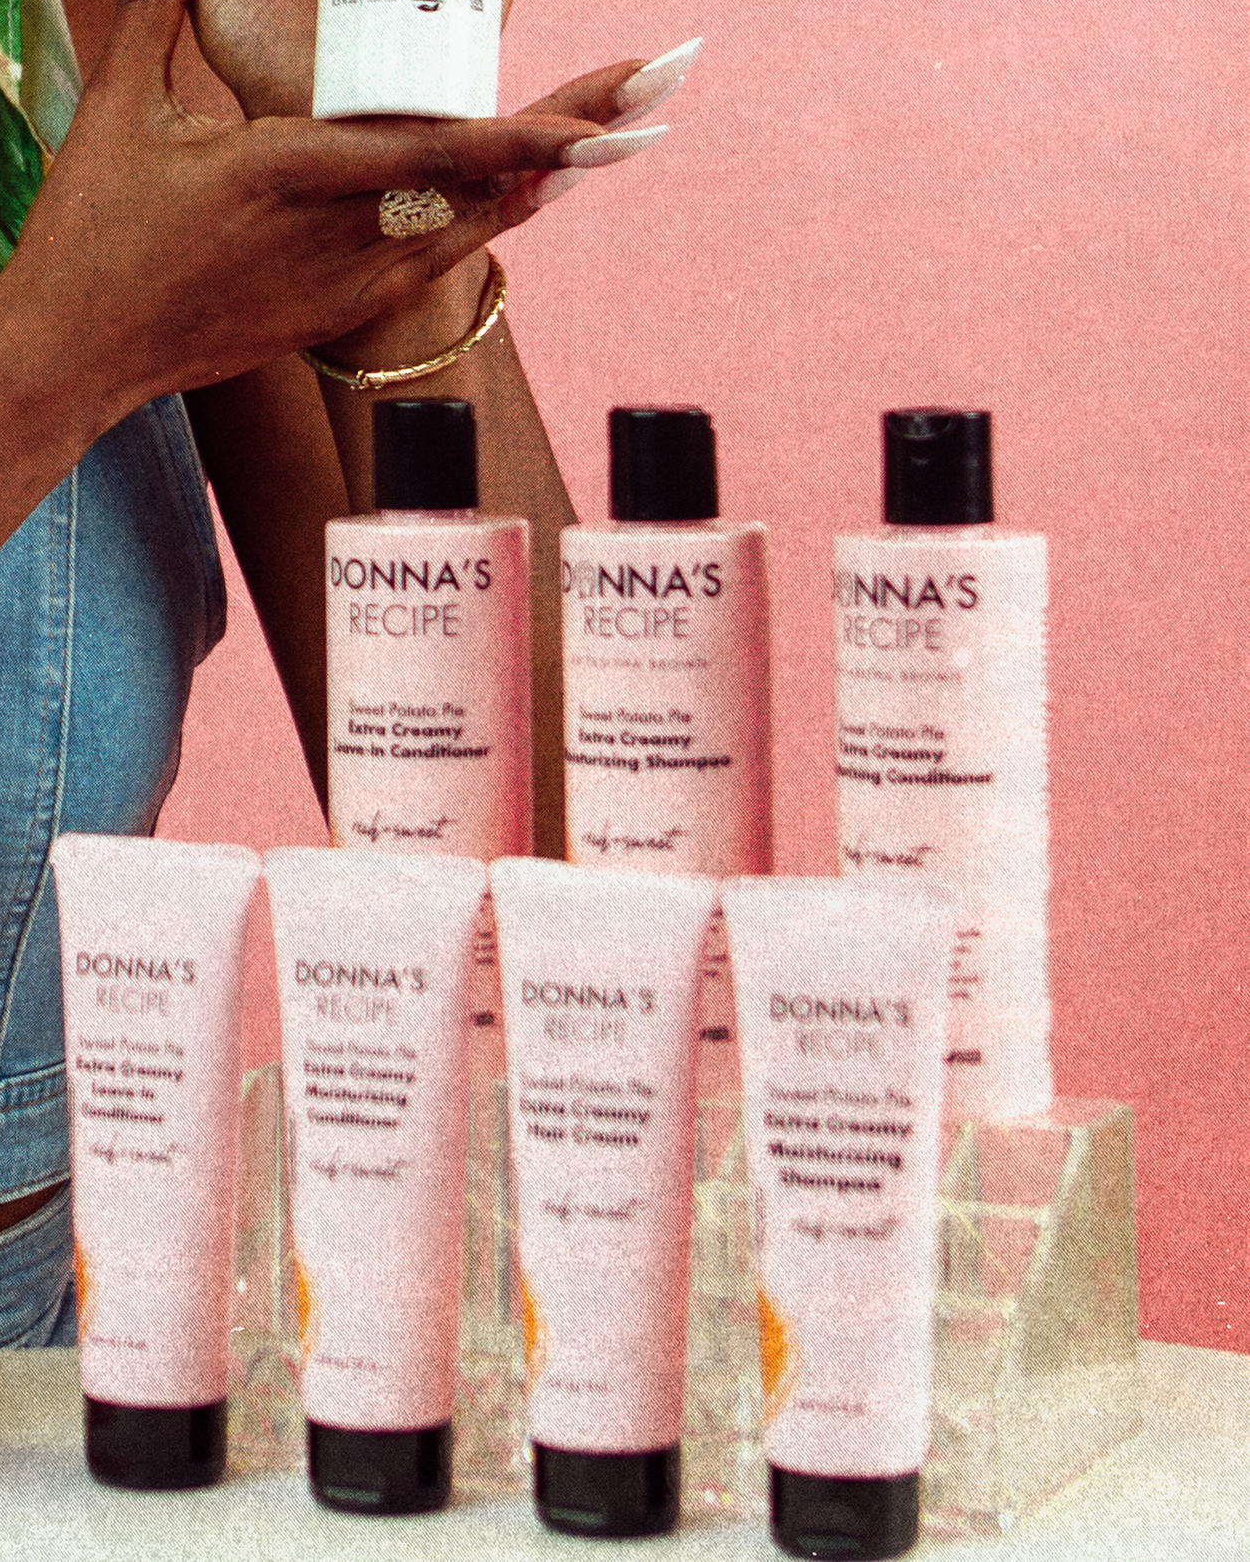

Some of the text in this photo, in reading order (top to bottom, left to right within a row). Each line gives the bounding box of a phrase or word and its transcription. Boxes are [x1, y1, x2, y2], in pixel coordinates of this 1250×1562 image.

[331, 557, 492, 591] DONNA'S
[838, 571, 978, 610] NNA'S
[350, 604, 460, 636] RECIPE
[584, 606, 689, 638] RECIPE
[350, 701, 464, 717] Sweet Potato Pie
[669, 708, 692, 723] Pie
[349, 722, 464, 740] Extra Creamy
[579, 728, 692, 750] Extra Creamy
[390, 743, 492, 759] Conditioner
[646, 755, 731, 771] Shampoo
[873, 744, 944, 764] Creamy
[887, 768, 994, 785] Conditioner
[76, 951, 196, 985] DONNA'S
[295, 959, 427, 993] DONNA'S
[96, 987, 170, 1016] RECIPE
[316, 994, 399, 1025] RECIPE
[521, 979, 654, 1015] DONNA'S
[770, 993, 911, 1027] DONNA'S
[544, 1014, 626, 1044] RECIPE
[76, 1056, 184, 1082] Extra Creamy
[304, 1061, 416, 1084] Extra Creamy
[82, 1104, 165, 1124] Conditioner
[520, 1096, 650, 1124] Extra Creamy
[765, 1109, 912, 1137] Extra Creamy
[780, 1168, 882, 1193] Shampoo
